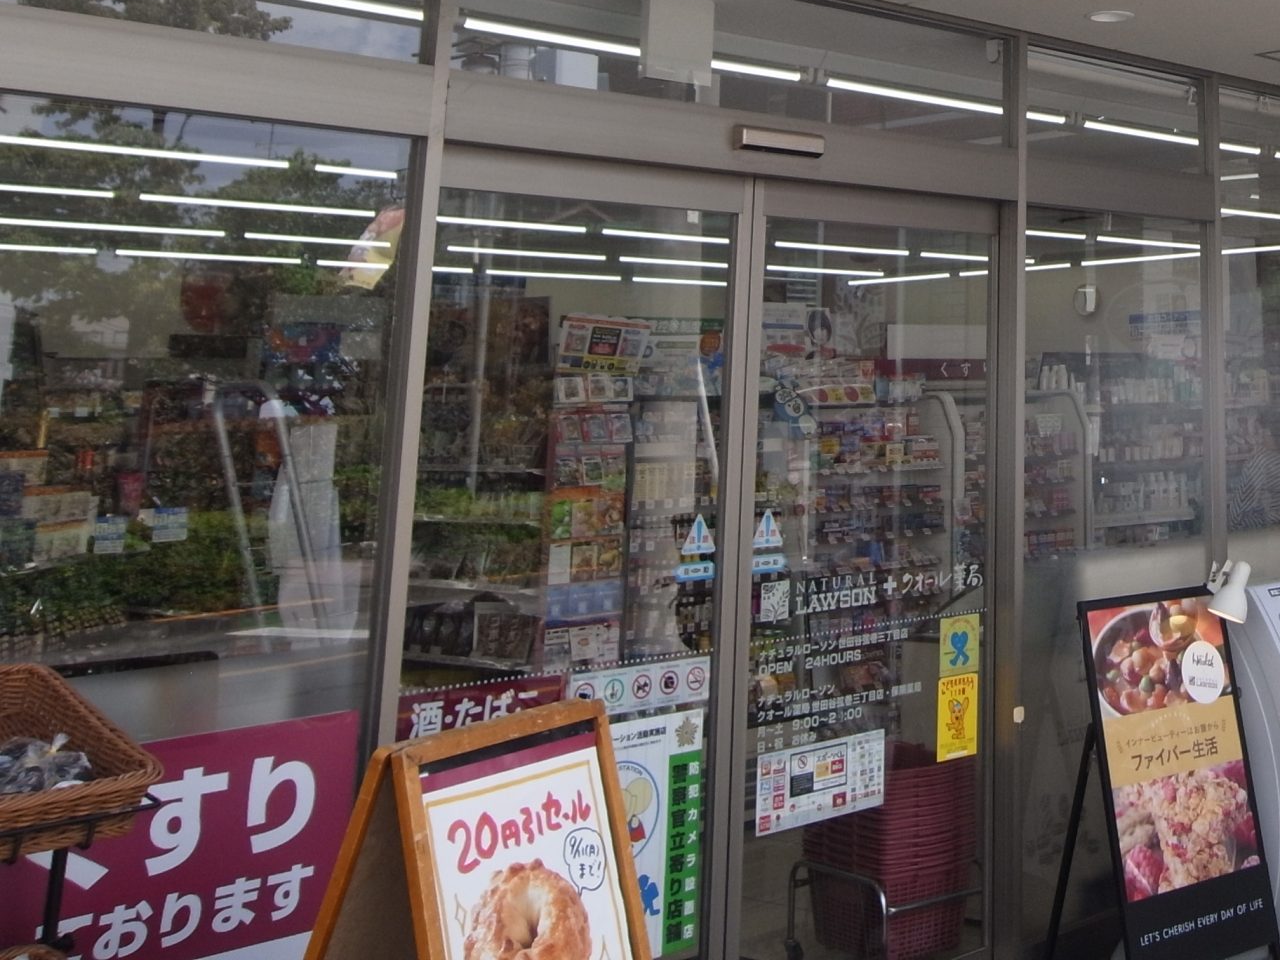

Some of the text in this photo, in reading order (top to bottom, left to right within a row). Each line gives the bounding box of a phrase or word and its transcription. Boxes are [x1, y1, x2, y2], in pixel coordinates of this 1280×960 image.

[796, 571, 877, 594] NATURAL
[795, 586, 877, 615] LAWSON
[758, 649, 862, 676] OPEN 24HOURS
[757, 684, 836, 708] ナチュラルローソン
[1131, 736, 1219, 771] ファイバー生活
[447, 790, 592, 874] 20円引セール
[1140, 898, 1264, 946] LET'S CHERISH EVERY DAY OF LIFE
